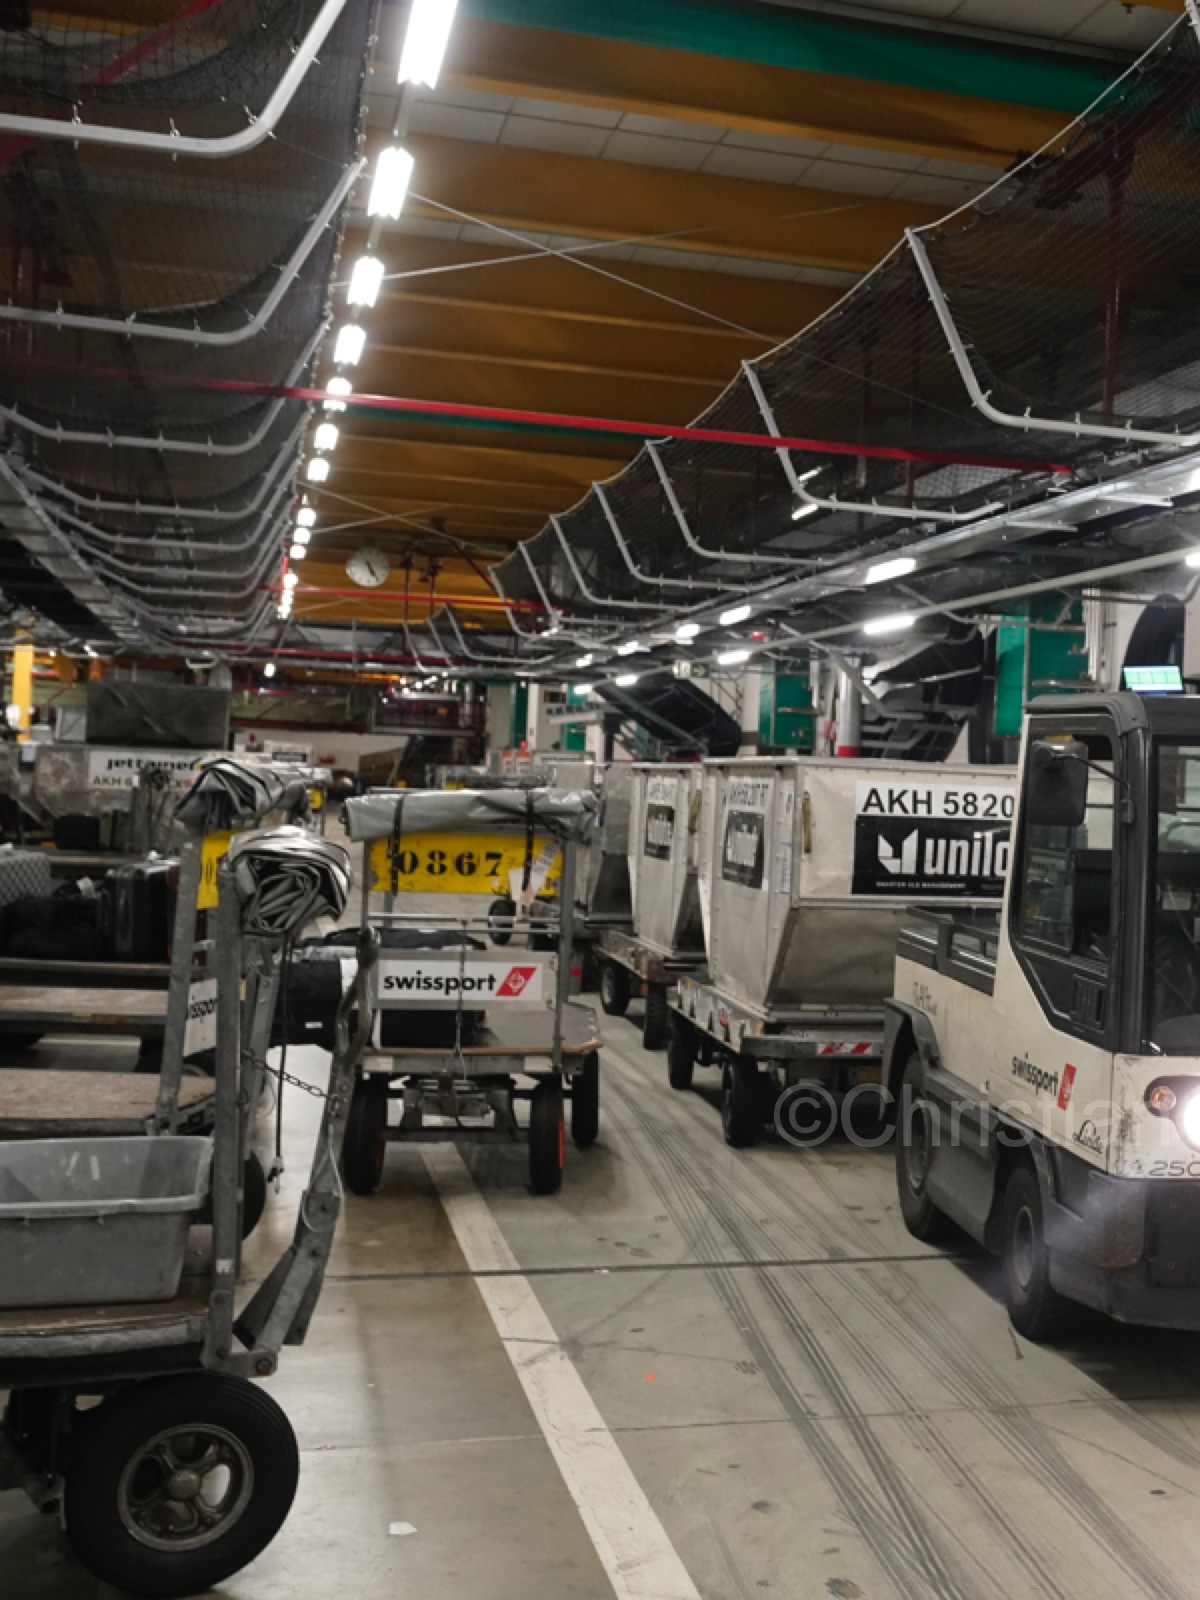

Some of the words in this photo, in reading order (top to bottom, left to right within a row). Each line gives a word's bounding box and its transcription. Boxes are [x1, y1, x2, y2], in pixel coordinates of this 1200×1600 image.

[861, 787, 933, 815] AKH
[943, 791, 1015, 819] 5820
[396, 850, 503, 877] 0867
[383, 969, 496, 996] swissport
[1011, 1052, 1059, 1096] swissport
